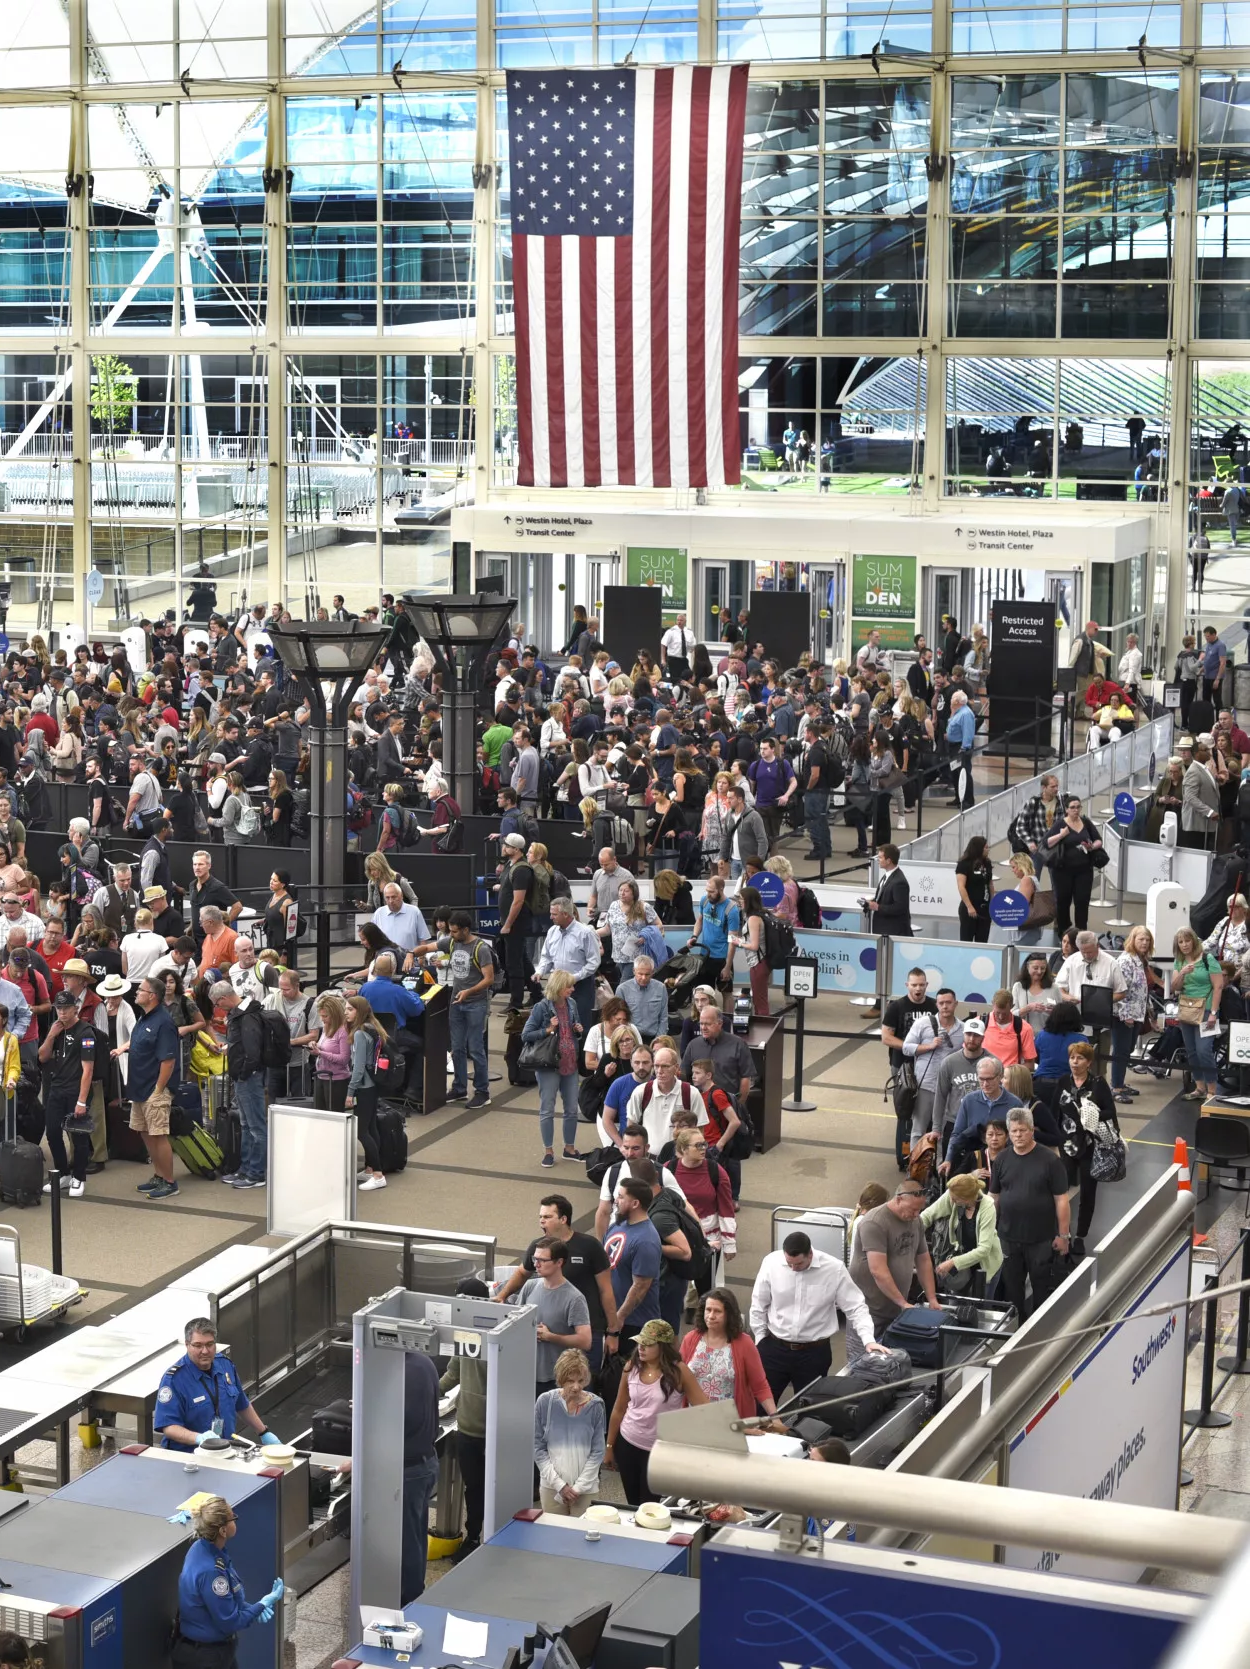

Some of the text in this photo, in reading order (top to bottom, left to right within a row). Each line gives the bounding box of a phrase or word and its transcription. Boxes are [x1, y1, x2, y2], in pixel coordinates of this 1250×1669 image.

[1008, 530, 1030, 538] Hotel,
[1032, 530, 1053, 538] Plaza
[1007, 542, 1034, 550] Center
[640, 555, 674, 569] SUM
[866, 561, 902, 577] SUM
[640, 569, 674, 583] MER
[866, 577, 902, 591] MER
[866, 591, 901, 606] DEN
[1002, 615, 1044, 625] Restricted
[1009, 626, 1037, 636] Access
[910, 895, 943, 904] CLEAR
[800, 947, 850, 962] Access in
[91, 965, 106, 975] TSA
[793, 970, 811, 978] OPEN
[458, 1341, 480, 1358] 10
[1132, 1315, 1172, 1385] Southwest
